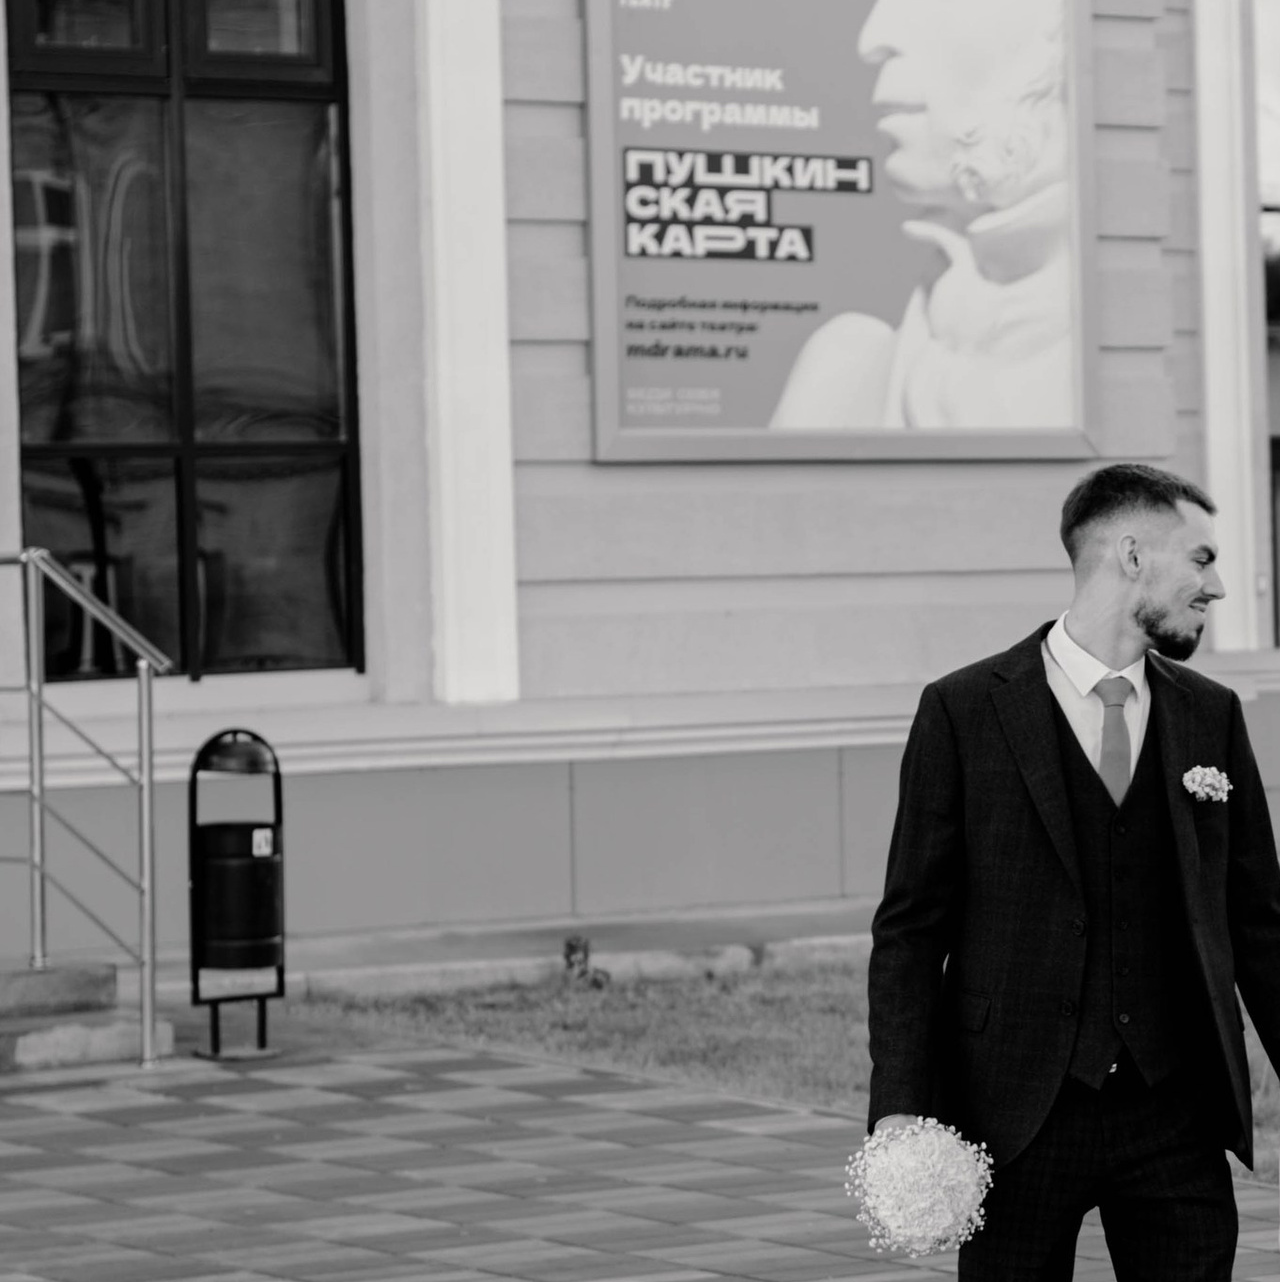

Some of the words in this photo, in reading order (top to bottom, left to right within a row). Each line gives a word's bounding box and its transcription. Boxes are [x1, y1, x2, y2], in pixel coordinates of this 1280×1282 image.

[619, 54, 784, 92] Участник
[619, 97, 821, 132] программы
[625, 150, 872, 192] ПУШКИН
[625, 185, 769, 223] СКАЯ
[626, 222, 811, 260] КАРТА
[626, 338, 749, 359] mdrama.ru
